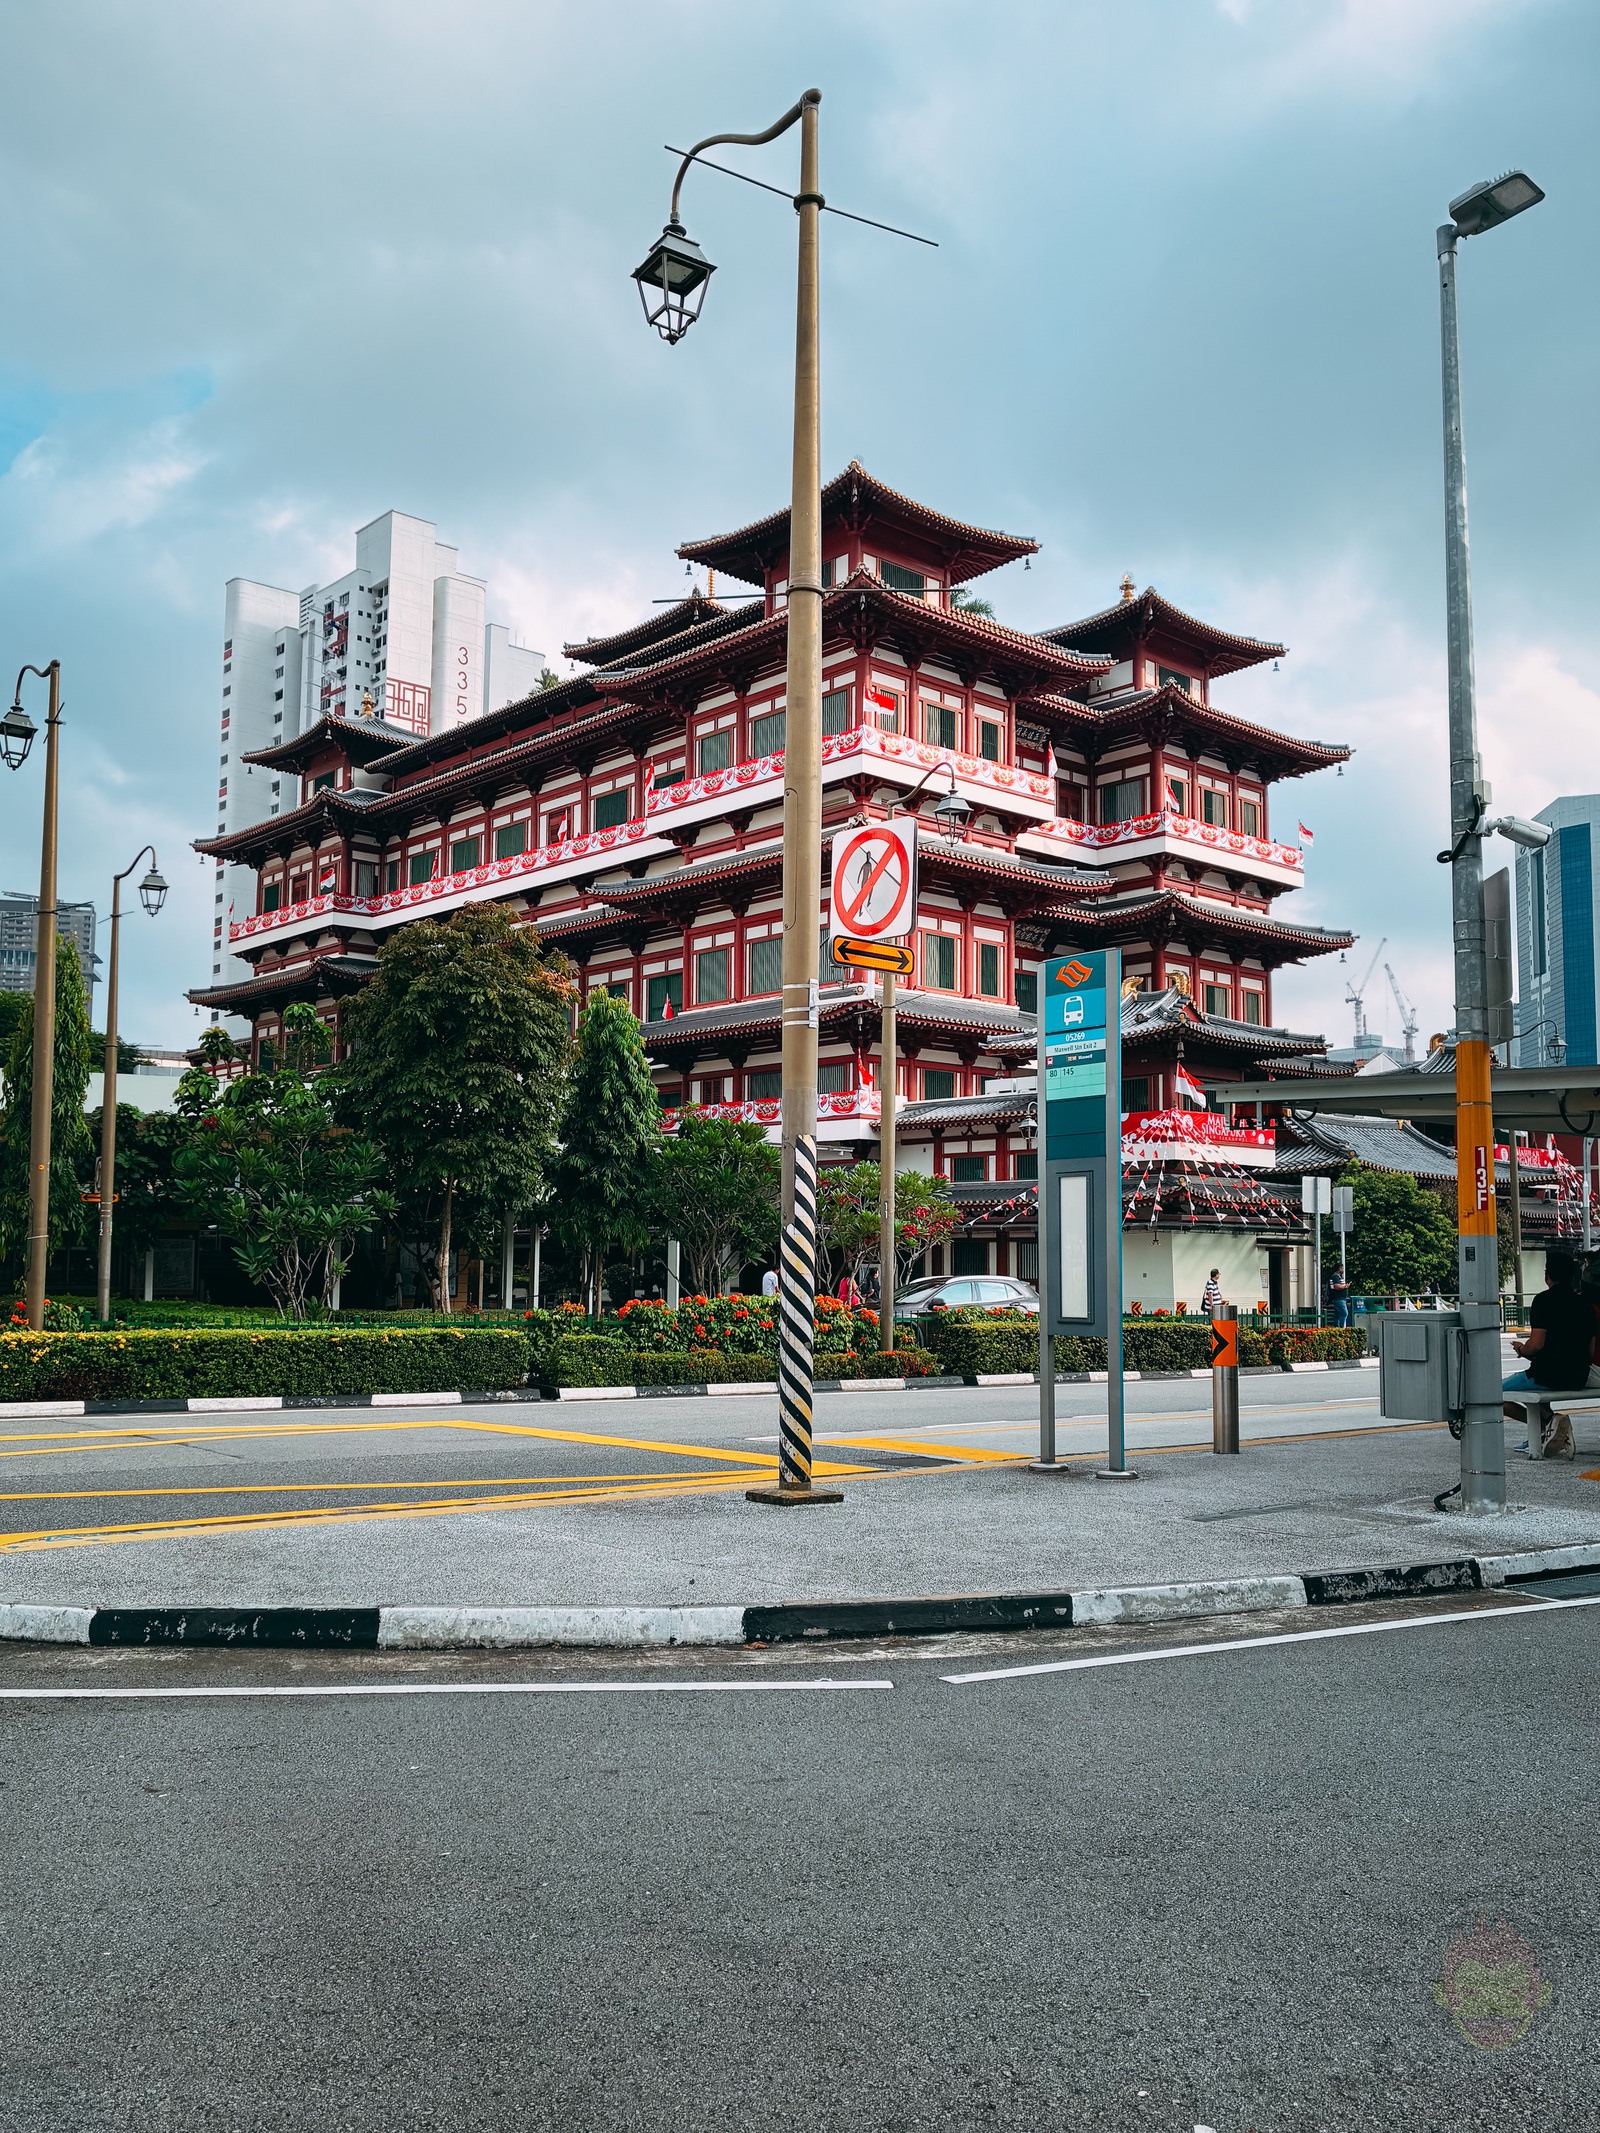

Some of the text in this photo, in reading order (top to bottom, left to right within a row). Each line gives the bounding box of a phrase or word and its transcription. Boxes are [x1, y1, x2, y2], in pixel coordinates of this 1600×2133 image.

[457, 647, 469, 726] 335
[1066, 1032, 1085, 1042] 05269
[1050, 1070, 1058, 1078] 80
[1476, 1146, 1487, 1210] 13F
